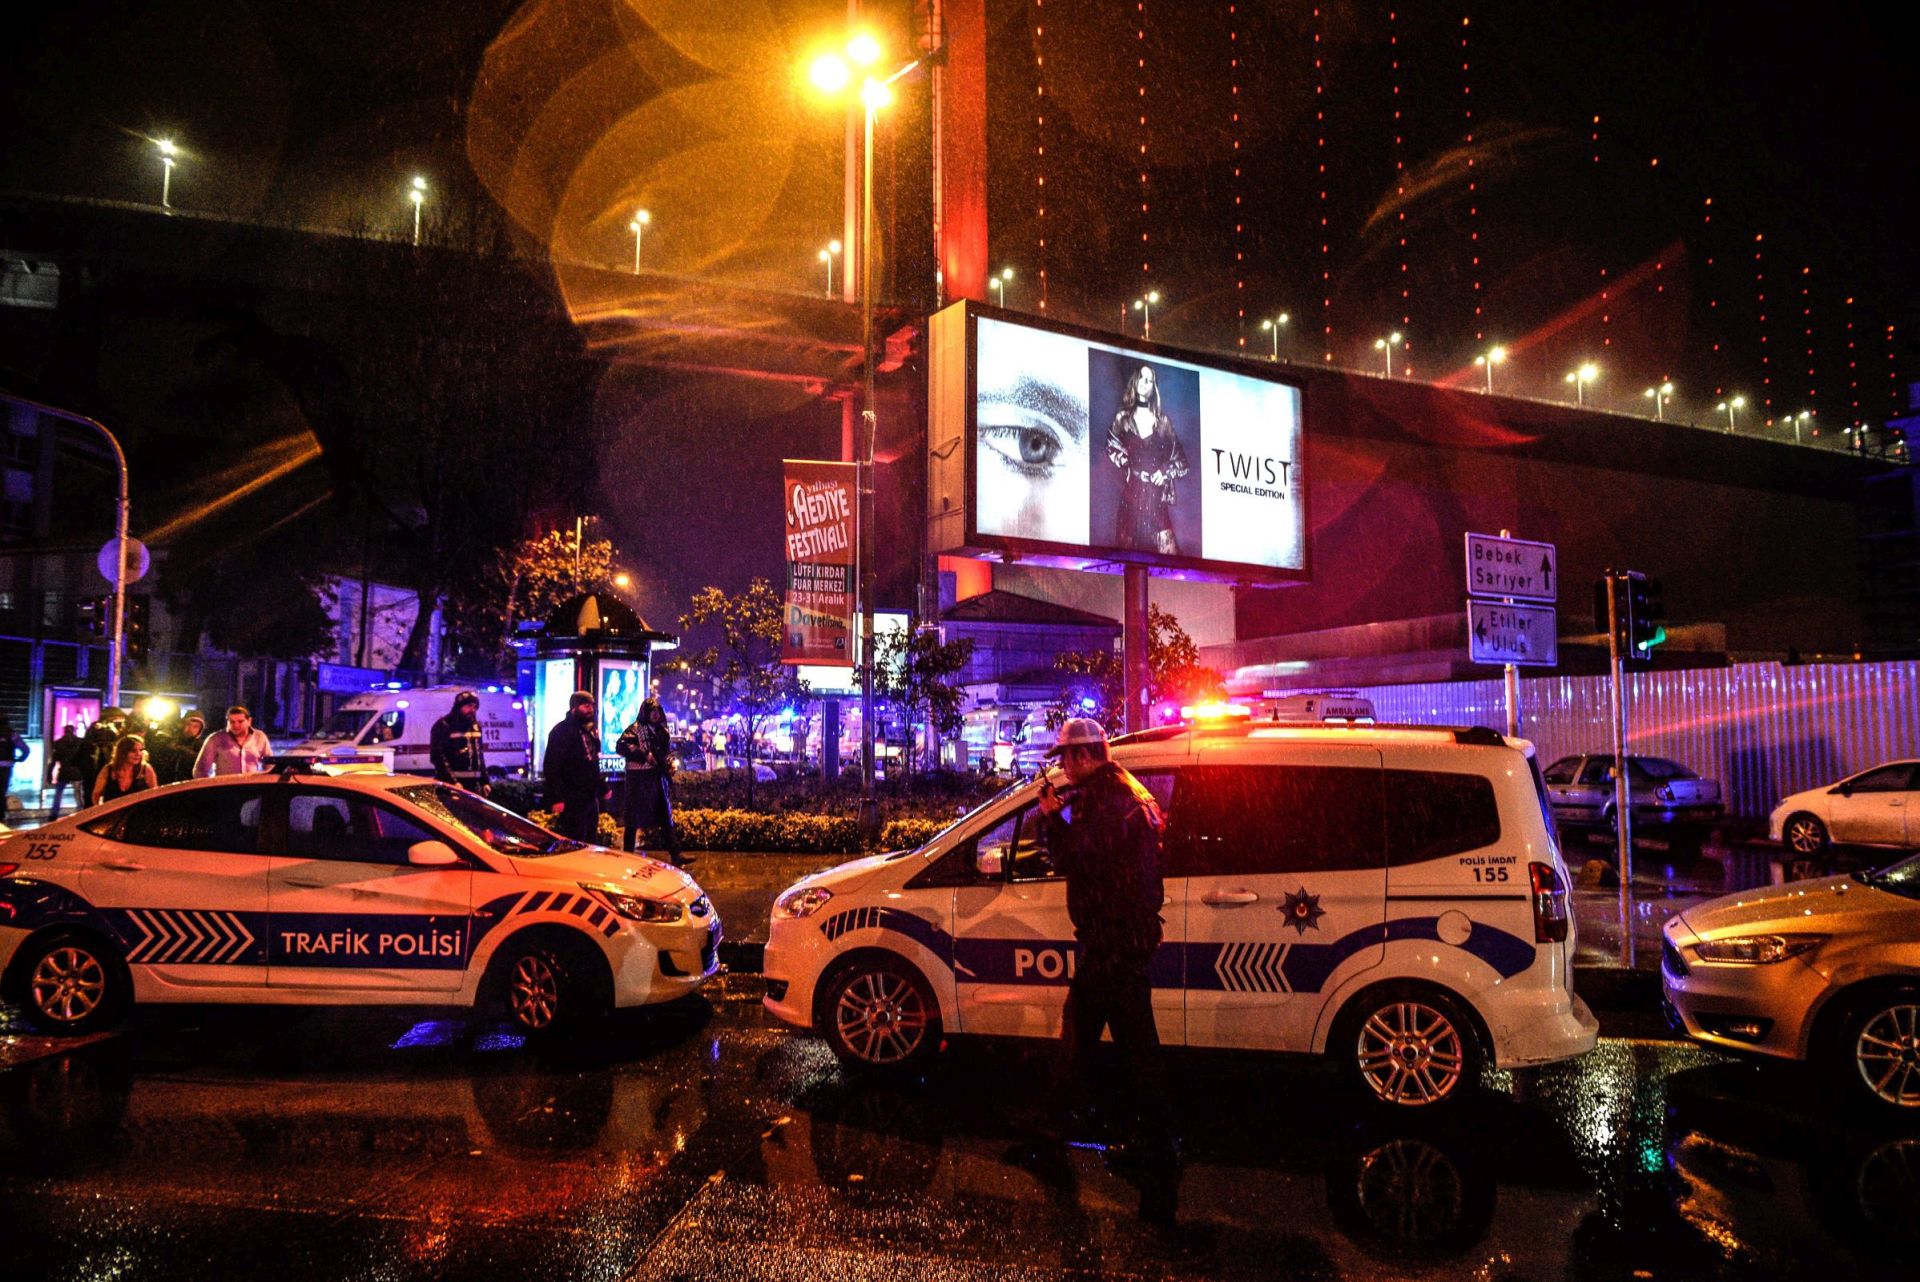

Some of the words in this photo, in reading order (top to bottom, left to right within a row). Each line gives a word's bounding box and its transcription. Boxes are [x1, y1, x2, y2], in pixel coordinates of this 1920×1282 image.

[1211, 448, 1291, 487] TWIST
[1220, 482, 1253, 495] SPECIAL
[1255, 487, 1285, 500] EDITION
[1475, 544, 1522, 565] Bebek
[816, 566, 846, 579] KIRDAR
[1476, 567, 1533, 591] Sarıyer
[793, 578, 812, 591] FUAR
[792, 591, 816, 604] 23-31
[818, 593, 845, 605] Aralık
[1490, 610, 1533, 630] Etiler
[1491, 634, 1527, 654] Ulus
[1325, 706, 1370, 716] AMBULANS
[485, 729, 501, 741] 112
[25, 843, 62, 860] 155
[1488, 855, 1517, 865] İMDAT
[1473, 867, 1509, 882] 155
[280, 927, 371, 955] TRAFİK
[379, 929, 461, 956] POLİSİ
